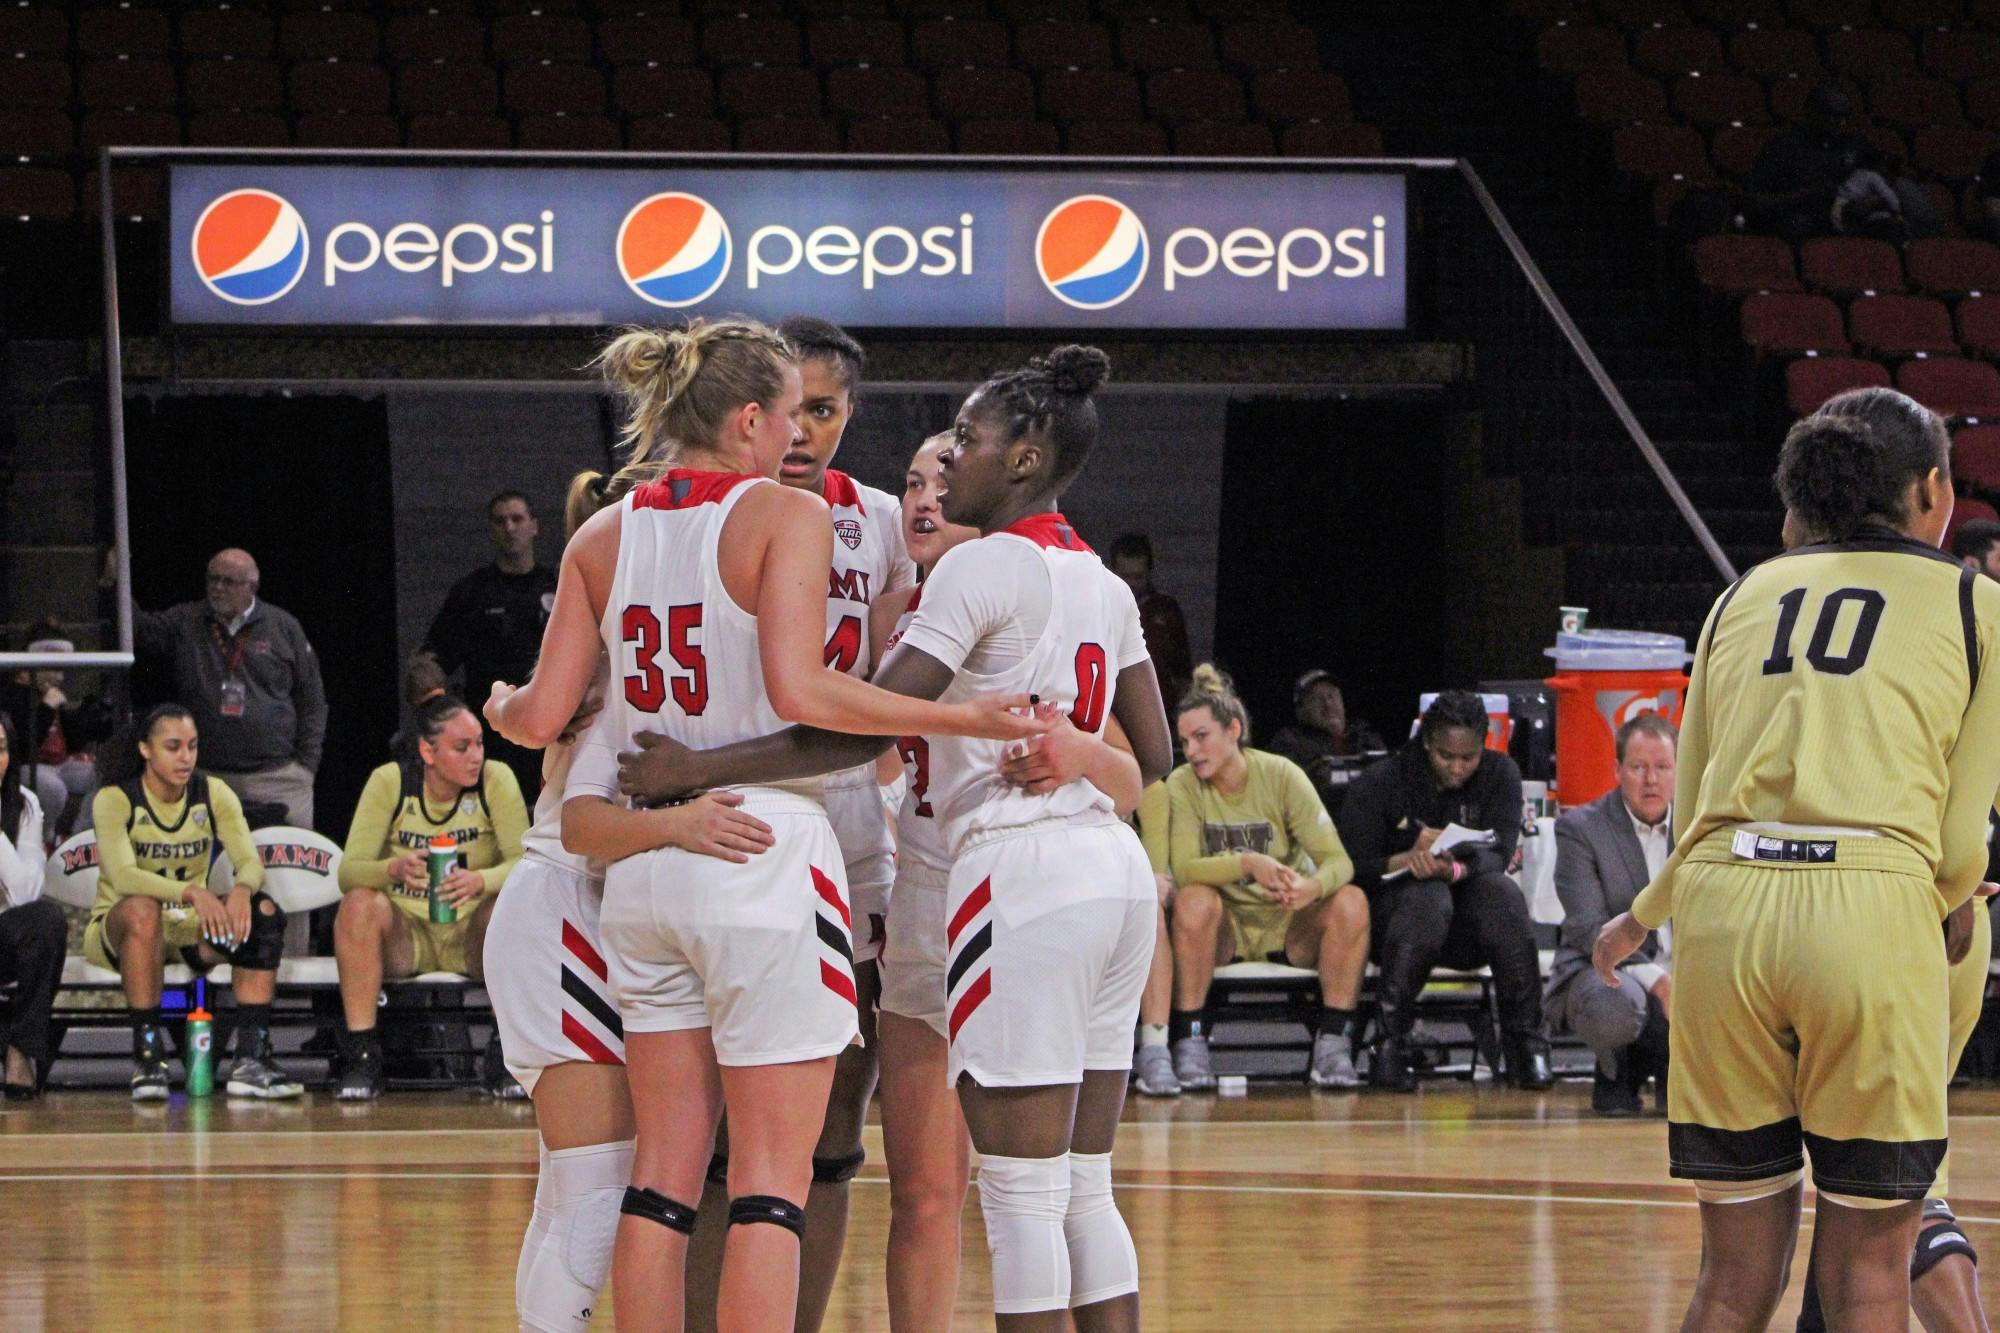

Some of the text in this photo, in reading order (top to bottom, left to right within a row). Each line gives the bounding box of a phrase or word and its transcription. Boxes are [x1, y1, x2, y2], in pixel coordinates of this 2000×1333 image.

[324, 210, 1386, 291] pepsi pepsi pepsi
[828, 567, 871, 606] MI
[622, 602, 709, 716] 35
[1762, 587, 1887, 676] 10
[256, 844, 333, 877] IAMI
[398, 827, 478, 849] WERN
